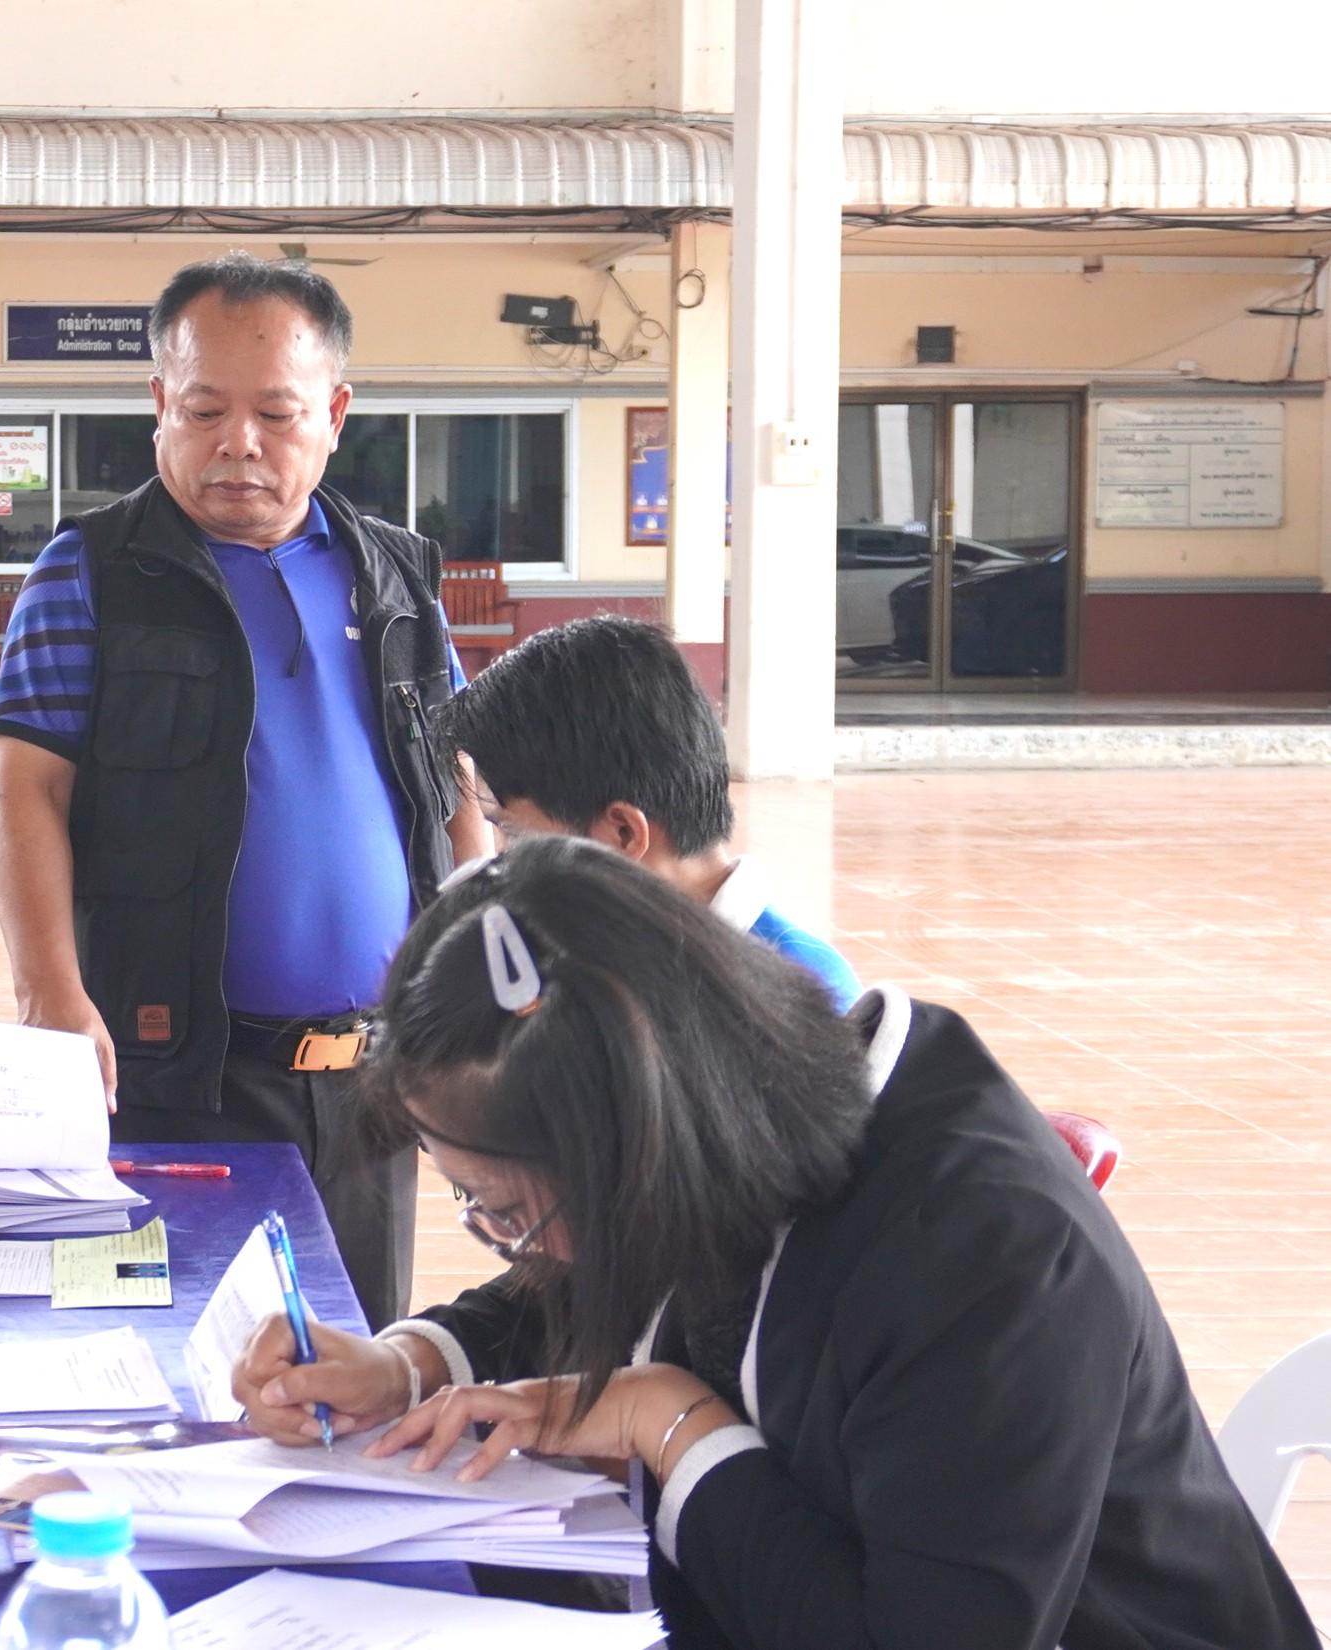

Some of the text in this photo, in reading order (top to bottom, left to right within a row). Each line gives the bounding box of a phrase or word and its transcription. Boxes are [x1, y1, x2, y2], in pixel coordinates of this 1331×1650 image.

[57, 312, 143, 338] กลุ่มอำนวยการ
[57, 339, 142, 353] Administration Group
